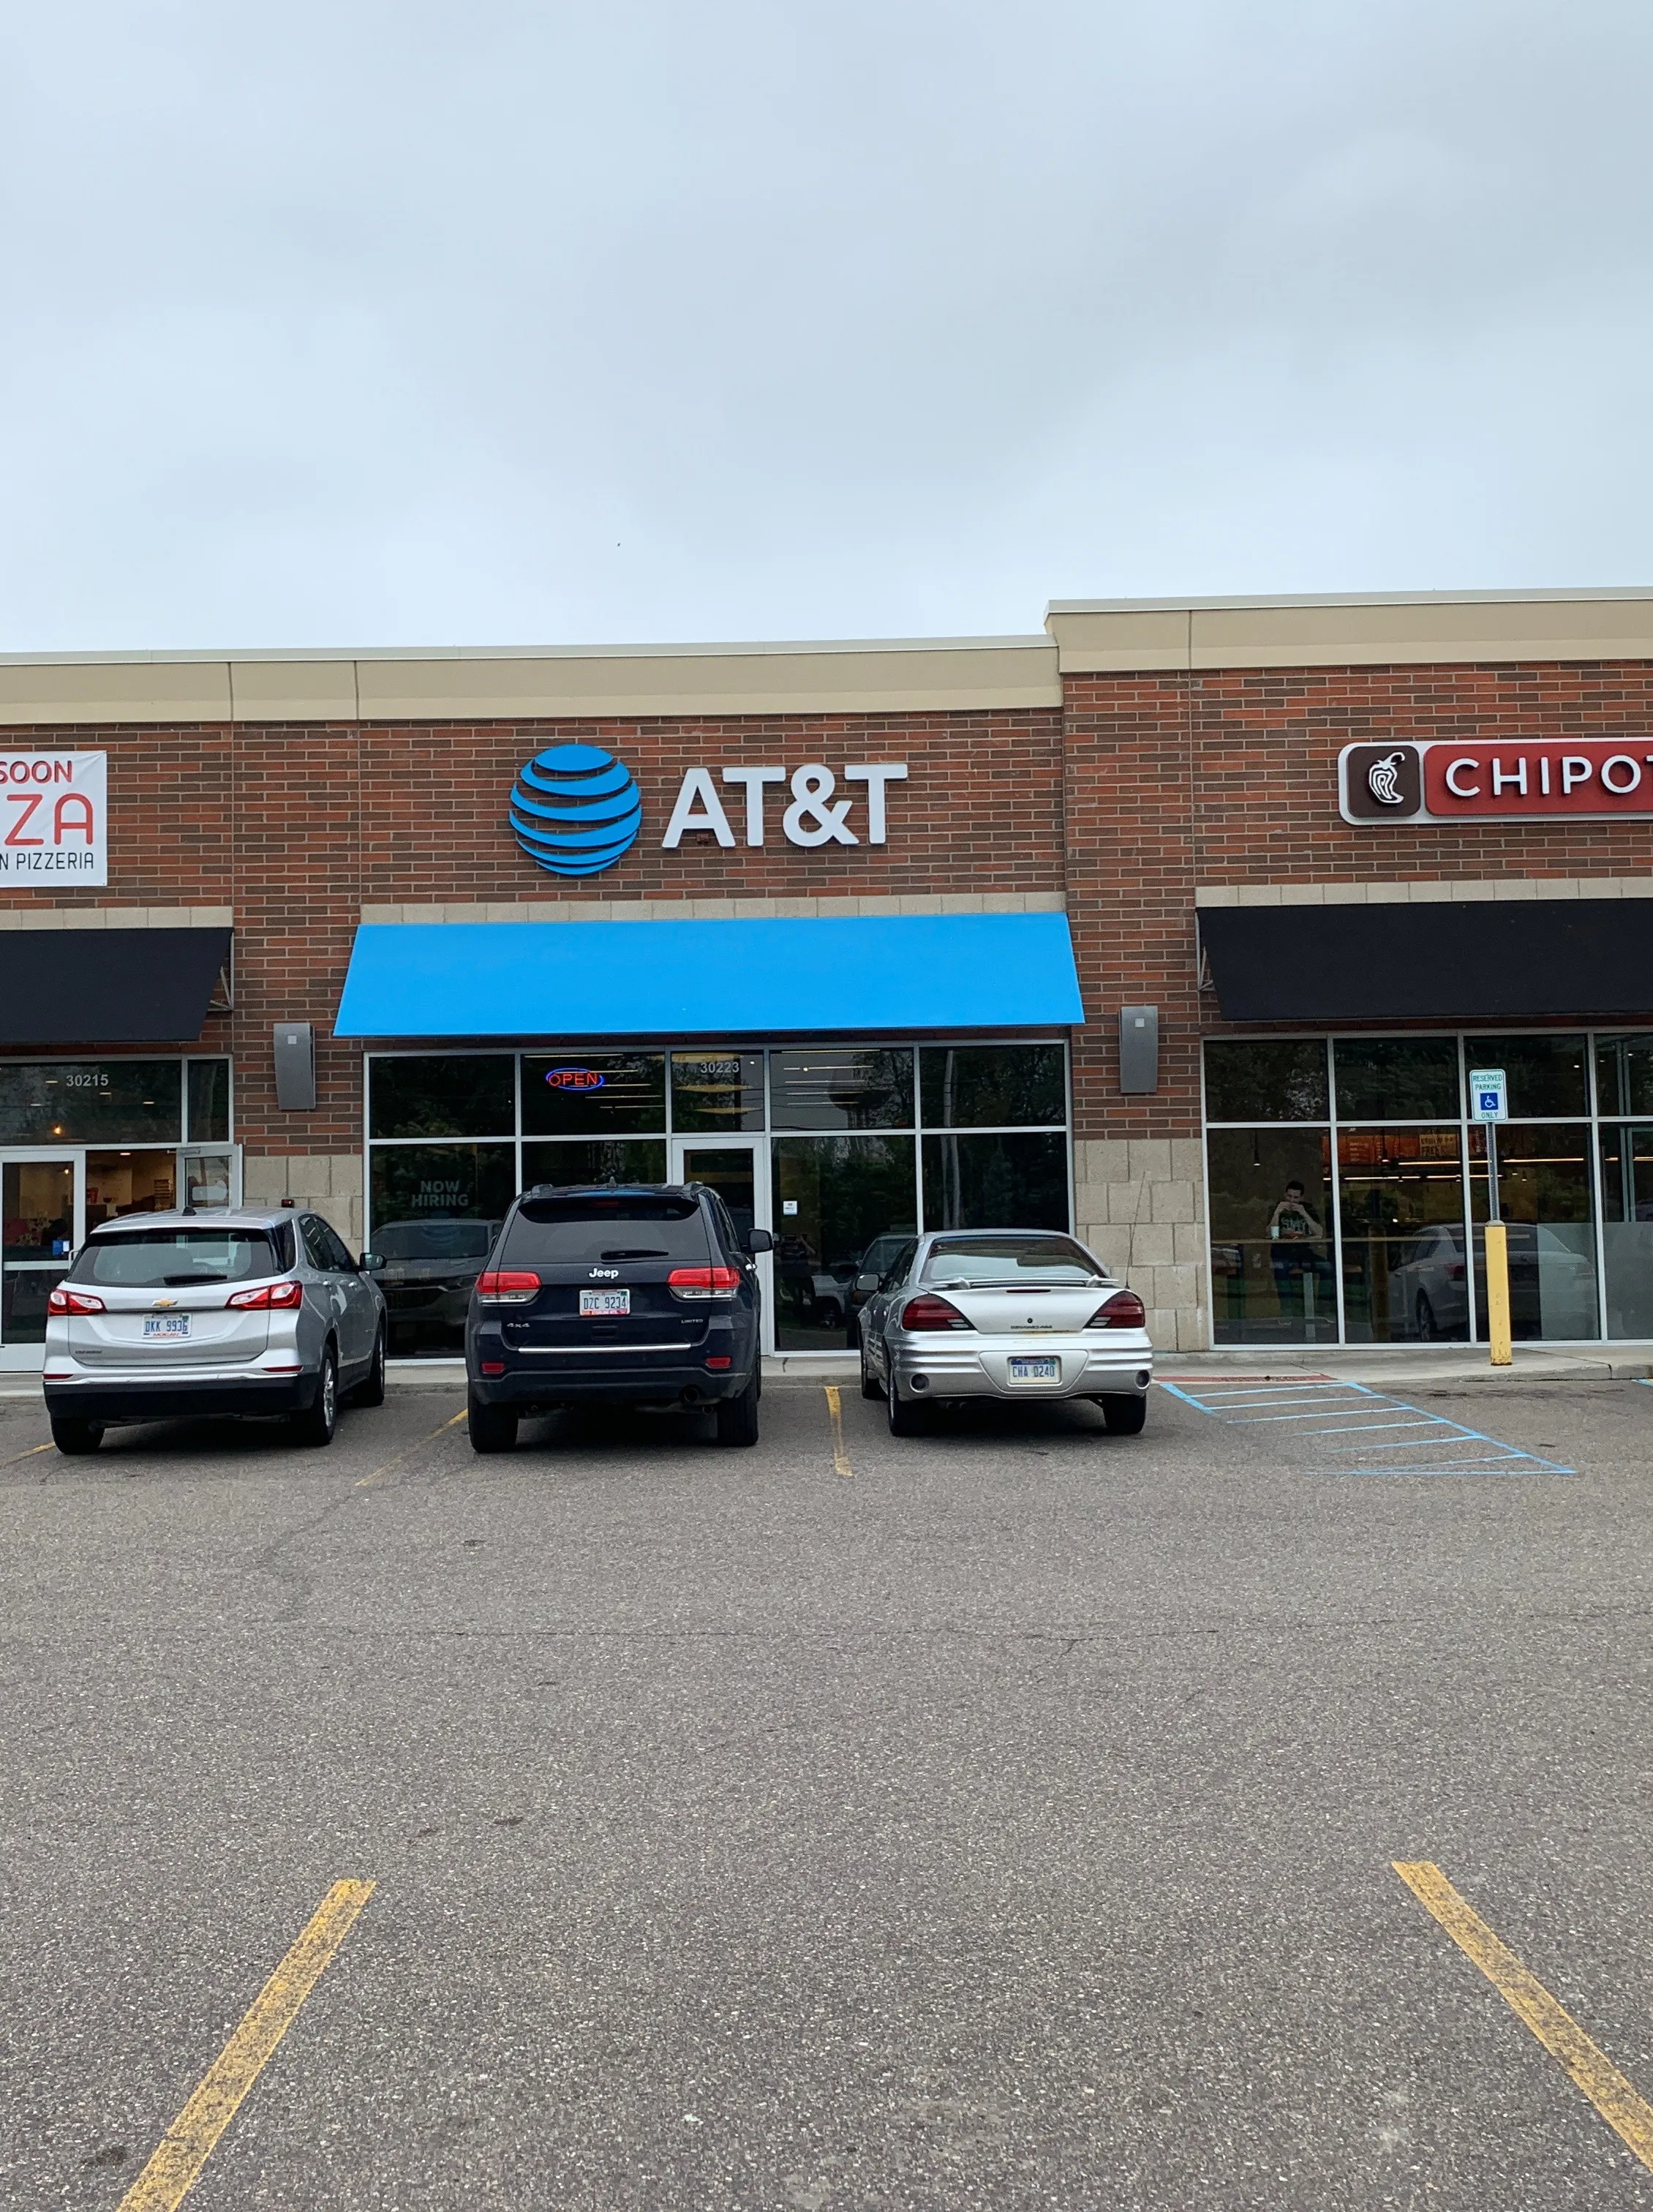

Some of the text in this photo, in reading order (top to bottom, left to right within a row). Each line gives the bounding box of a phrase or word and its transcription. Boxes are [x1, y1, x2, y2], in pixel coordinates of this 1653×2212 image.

[1445, 754, 1653, 797] CHIPO
[661, 763, 908, 849] AT&T
[16, 852, 94, 870] PIZZERIA
[700, 1061, 739, 1073] 30223
[66, 1074, 108, 1086] 30215
[549, 1072, 598, 1087] OPEN
[421, 1180, 460, 1192] NOW
[412, 1194, 468, 1207] HIRING
[589, 1268, 619, 1279] Jeep
[584, 1297, 599, 1309] DZC
